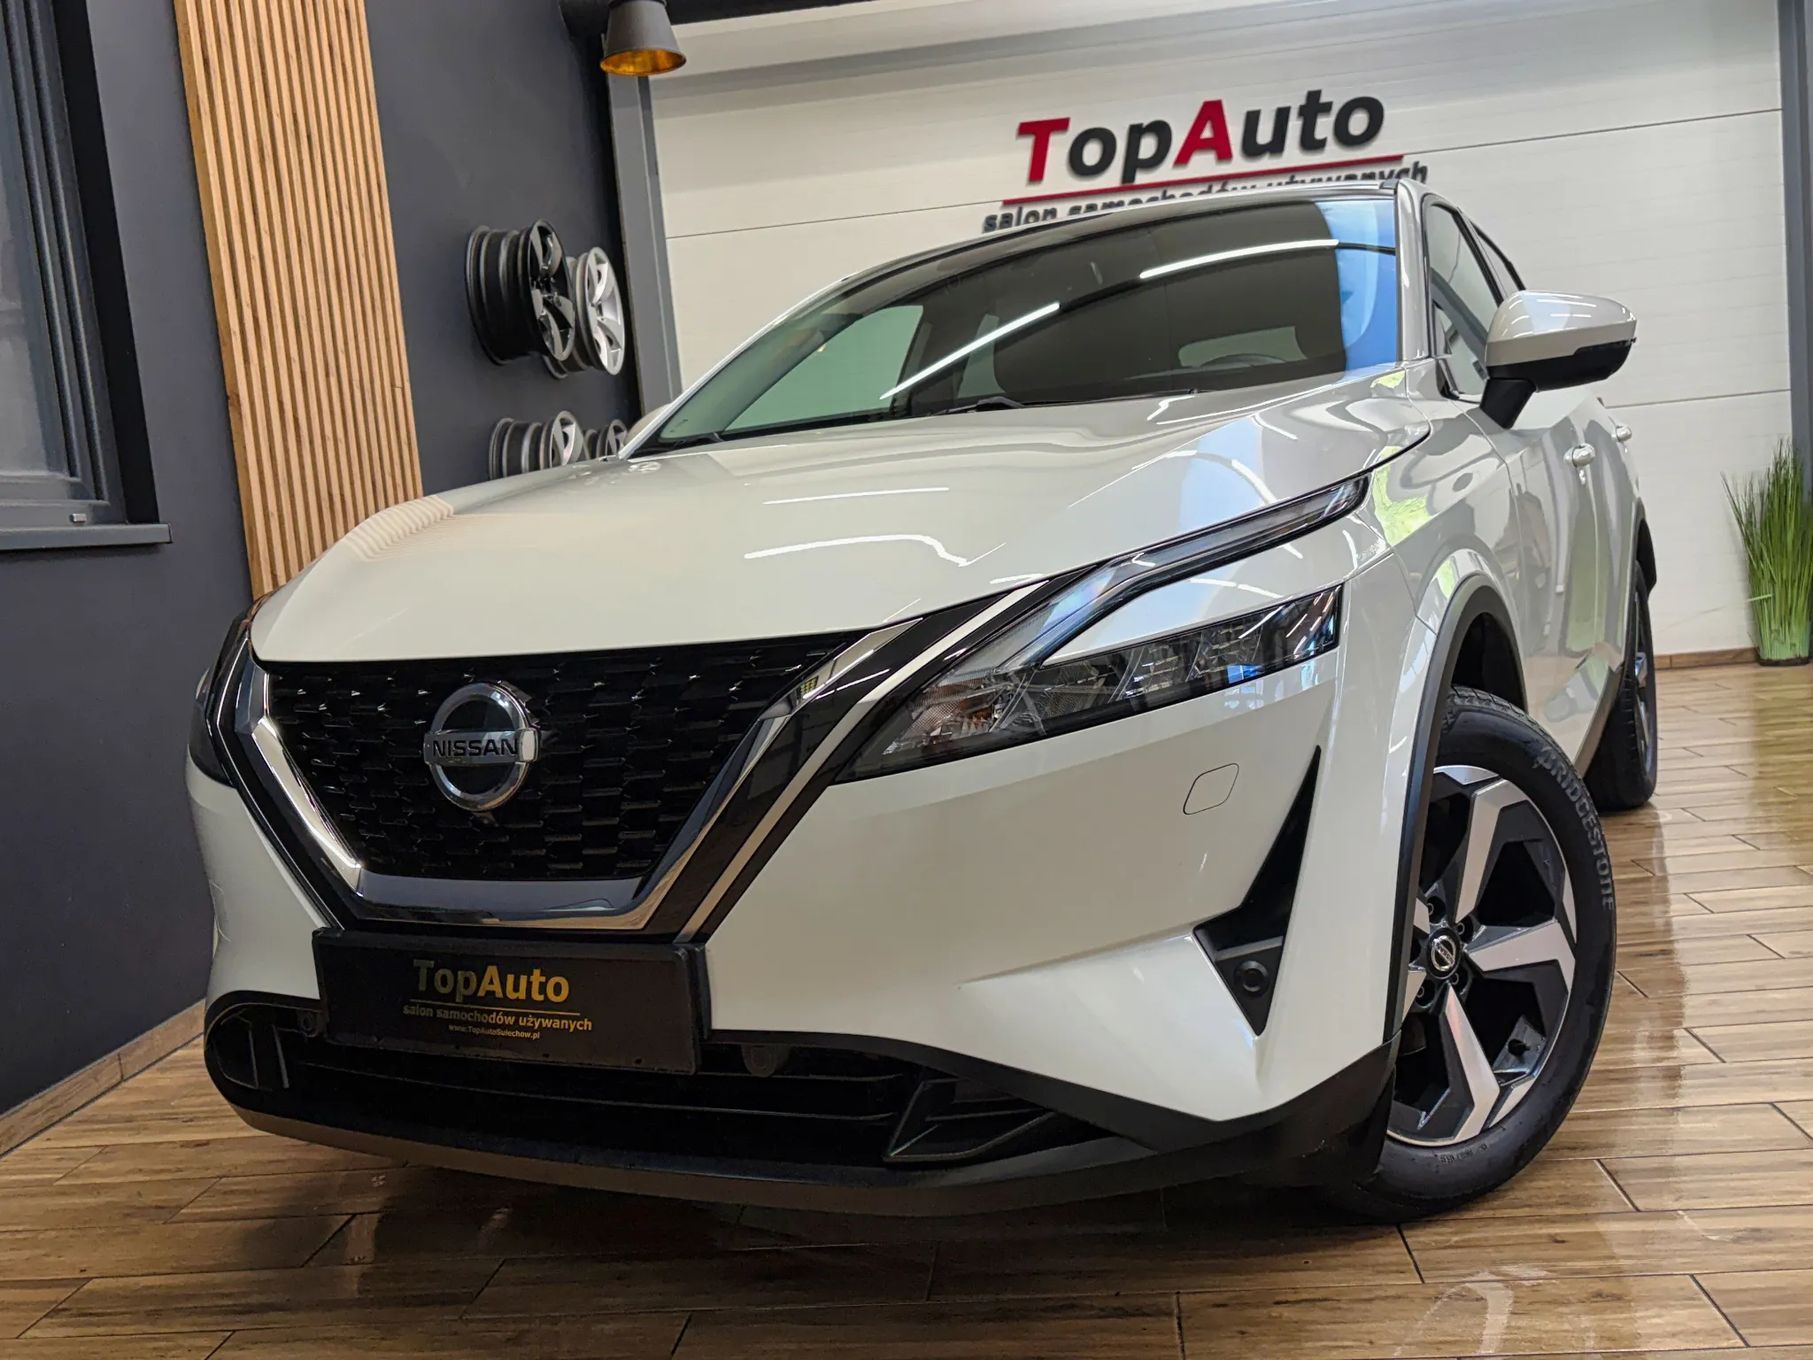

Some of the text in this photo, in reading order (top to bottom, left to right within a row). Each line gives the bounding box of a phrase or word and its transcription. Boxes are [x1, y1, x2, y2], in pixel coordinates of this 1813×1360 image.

[1017, 89, 1385, 184] TopAuto
[982, 206, 1057, 233] salon
[433, 738, 519, 757] NISSAN
[1536, 746, 1615, 911] BRIDGESTONE
[413, 959, 570, 1003] TopAuto
[403, 1003, 592, 1033] salon samochodów używanych
